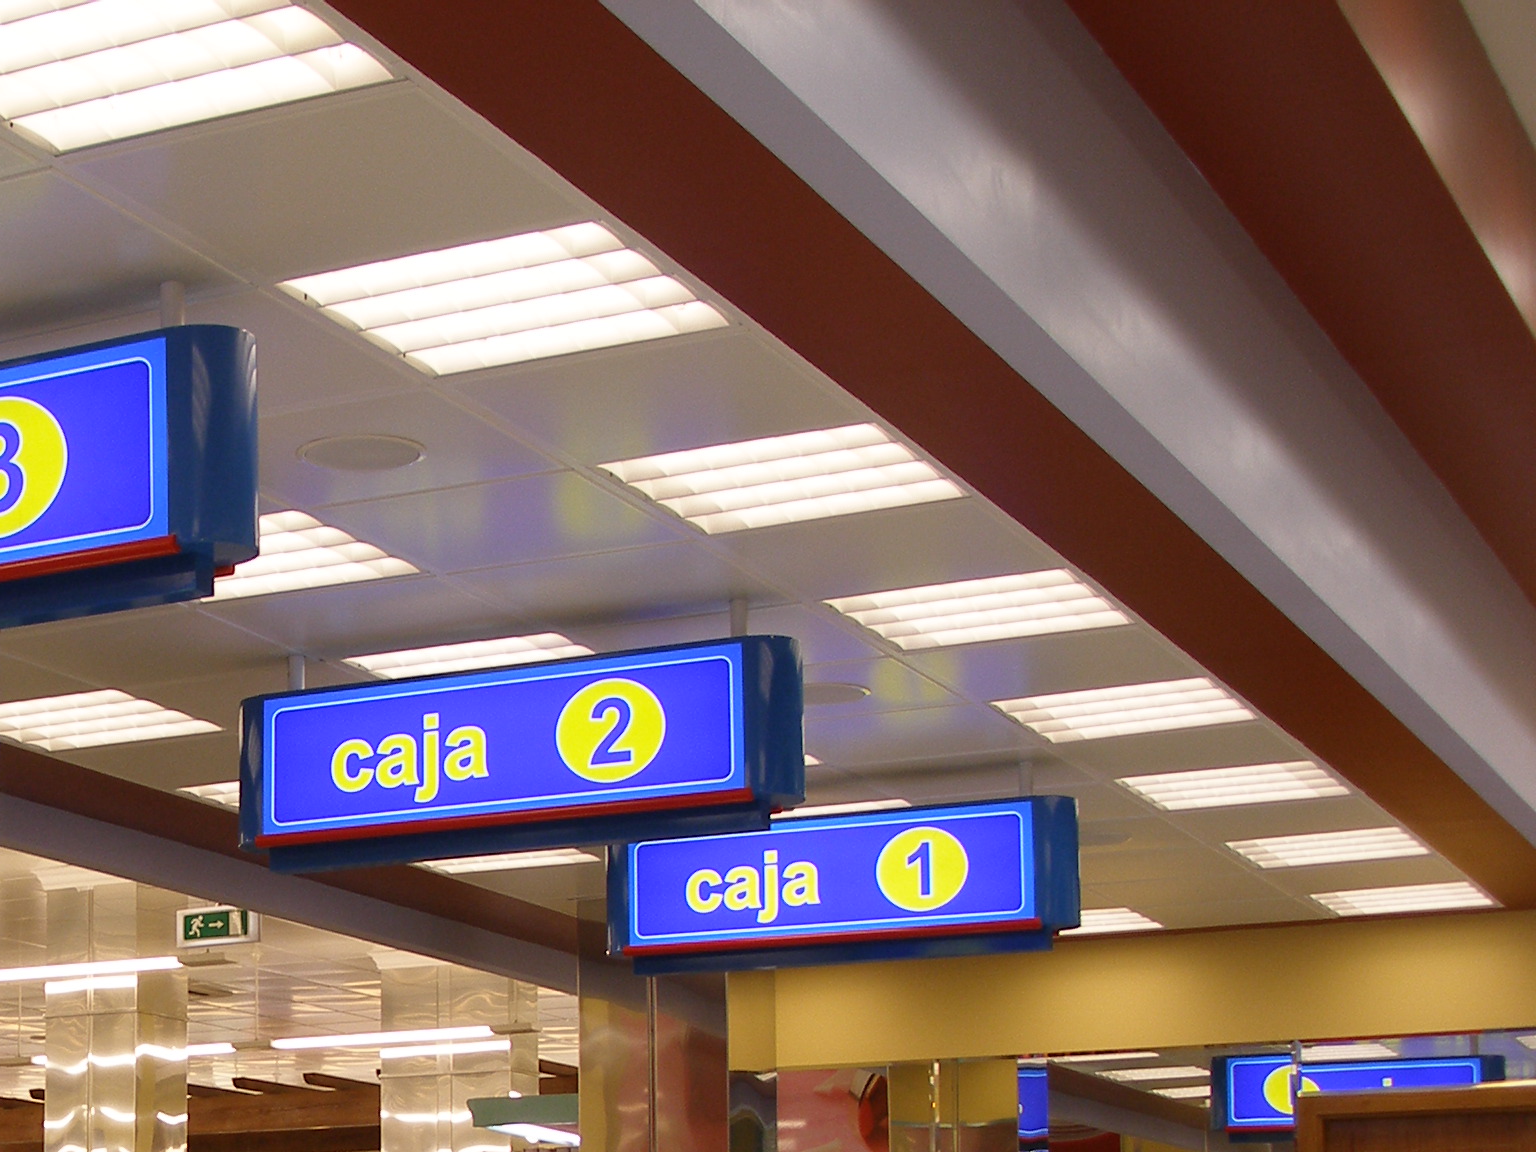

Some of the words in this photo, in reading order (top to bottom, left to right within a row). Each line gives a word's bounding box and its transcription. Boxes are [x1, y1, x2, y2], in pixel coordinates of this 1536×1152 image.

[330, 711, 489, 804] caja
[588, 697, 634, 769] 2
[685, 850, 822, 924] caja
[906, 841, 932, 898] 1
